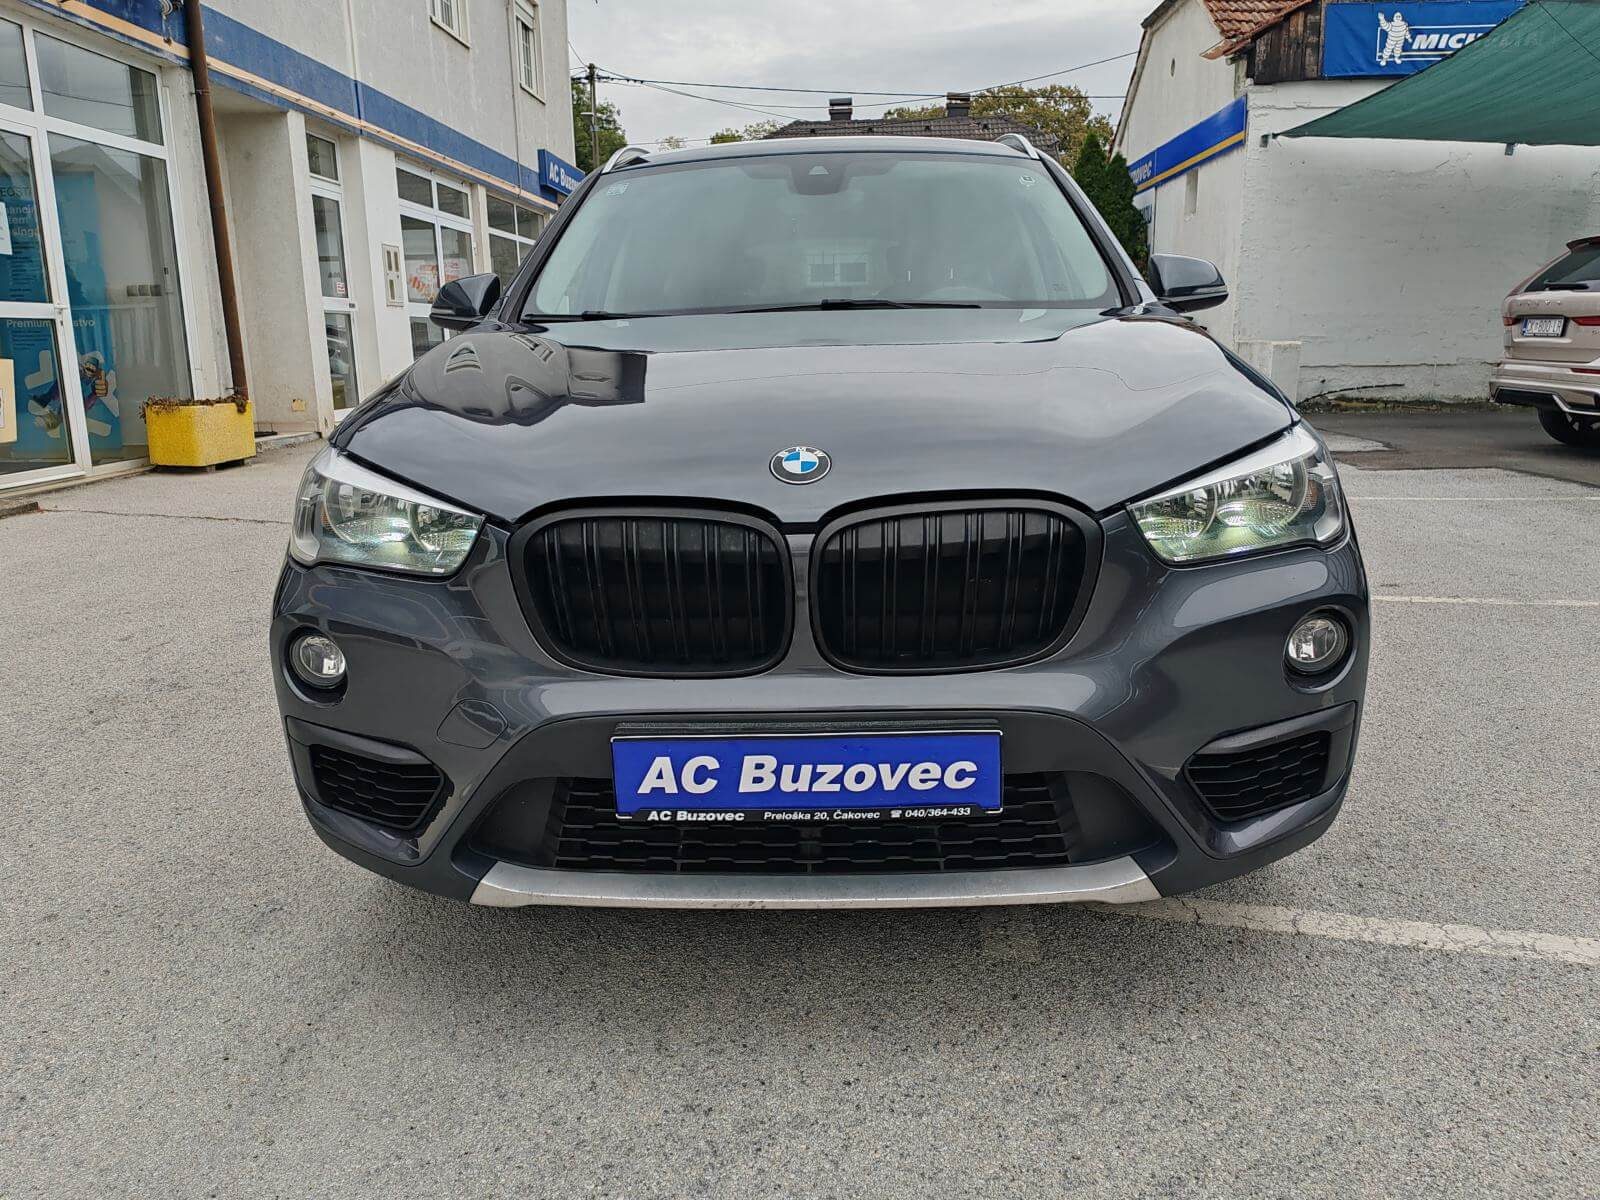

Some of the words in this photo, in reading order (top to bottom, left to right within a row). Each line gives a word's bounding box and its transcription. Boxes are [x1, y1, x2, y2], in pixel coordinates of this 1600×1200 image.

[549, 161, 560, 184] AC
[6, 319, 51, 329] Premium
[637, 755, 720, 794] AC
[738, 755, 978, 793] Buzovec
[647, 810, 671, 821] AC
[676, 810, 745, 821] Buzovec
[764, 811, 811, 820] Preloška
[814, 812, 830, 821] 20,
[833, 809, 881, 820] Čakovec
[905, 807, 971, 818] 040/364-433
